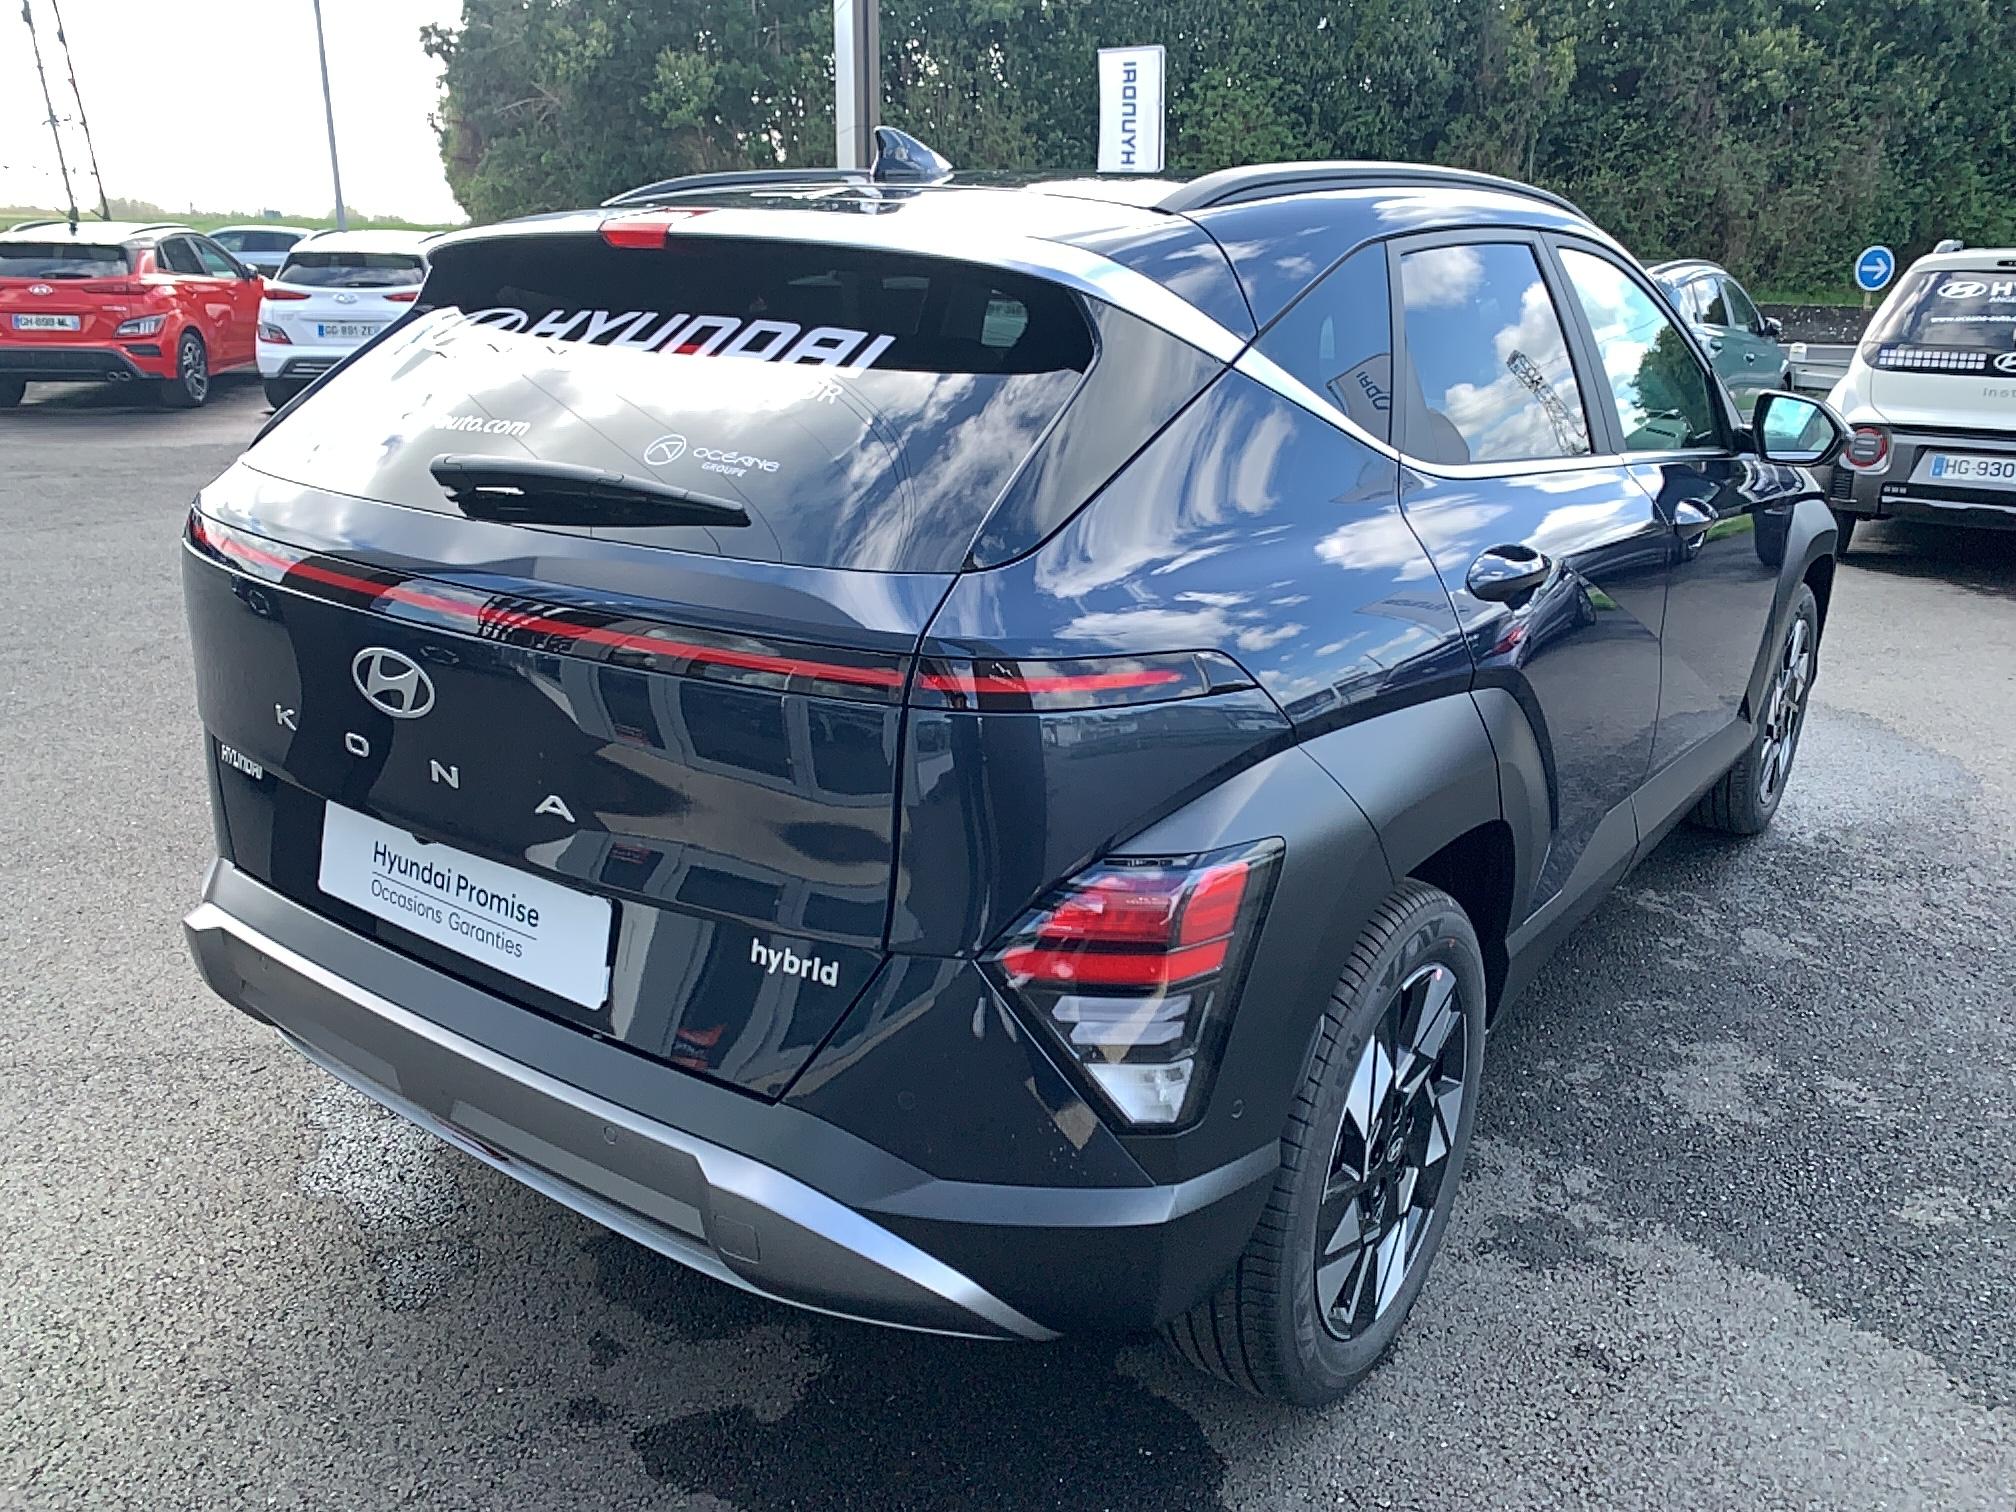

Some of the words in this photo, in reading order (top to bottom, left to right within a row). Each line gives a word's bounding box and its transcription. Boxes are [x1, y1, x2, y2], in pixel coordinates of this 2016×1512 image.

[1120, 62, 1137, 166] HYUNDAI
[527, 308, 897, 378] HYUNDAI
[221, 744, 264, 780] HYUNDAI
[371, 879, 443, 925] Occasions
[448, 911, 523, 958] Garanties
[373, 840, 452, 894] Hyundai
[455, 873, 540, 928] Promise
[750, 937, 840, 988] hybrid
